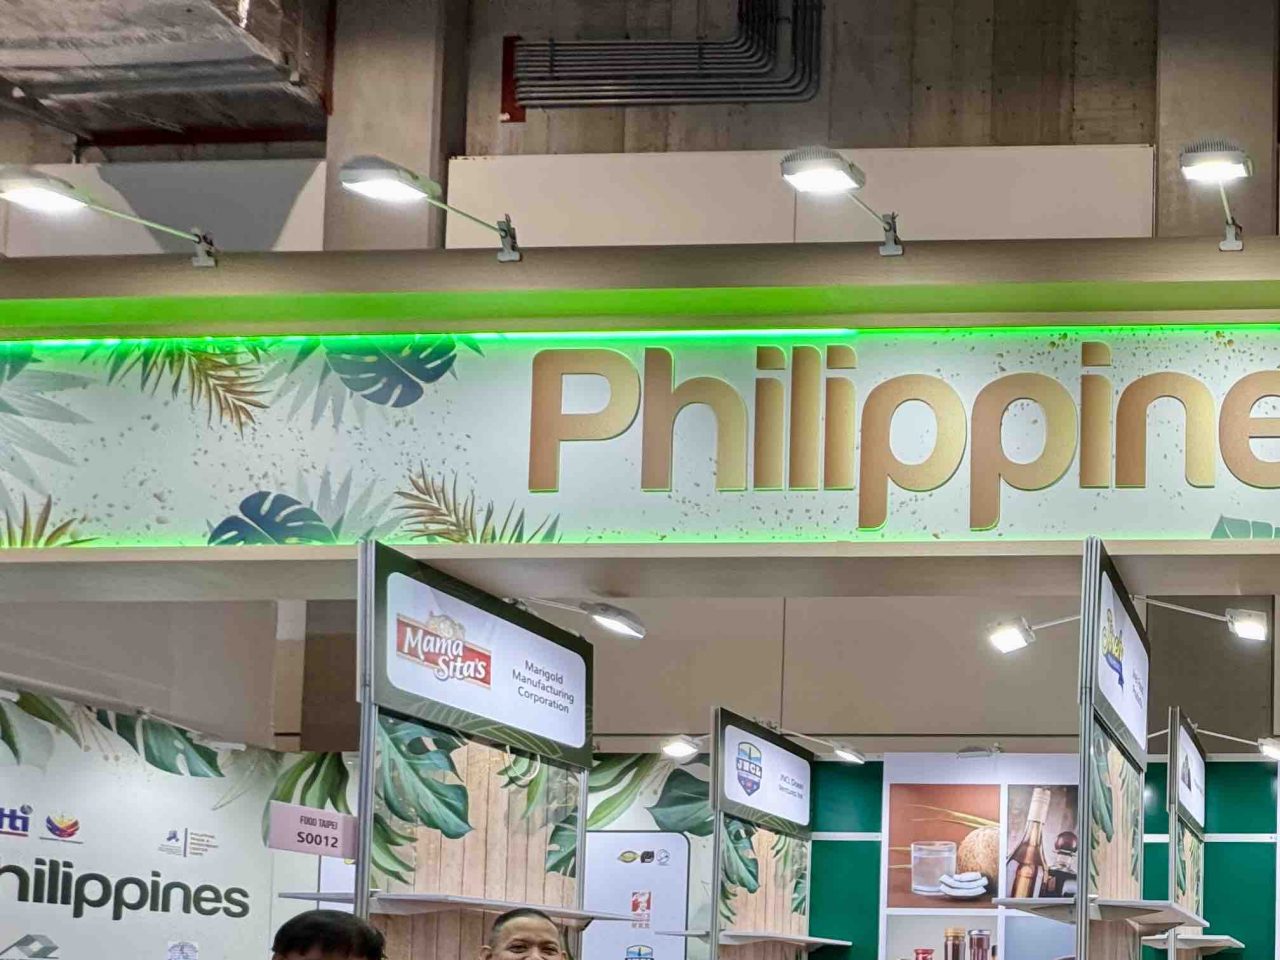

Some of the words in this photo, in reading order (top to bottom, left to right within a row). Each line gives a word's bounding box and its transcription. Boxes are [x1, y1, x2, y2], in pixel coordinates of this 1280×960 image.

[402, 626, 464, 661] Mama
[433, 655, 487, 681] Sita's
[524, 659, 564, 685] Marigold
[512, 669, 575, 704] Manufacturing
[517, 686, 570, 714] Corporation
[299, 815, 317, 827] FOOD
[318, 818, 338, 830] TAIPEI
[297, 831, 339, 848] S0012
